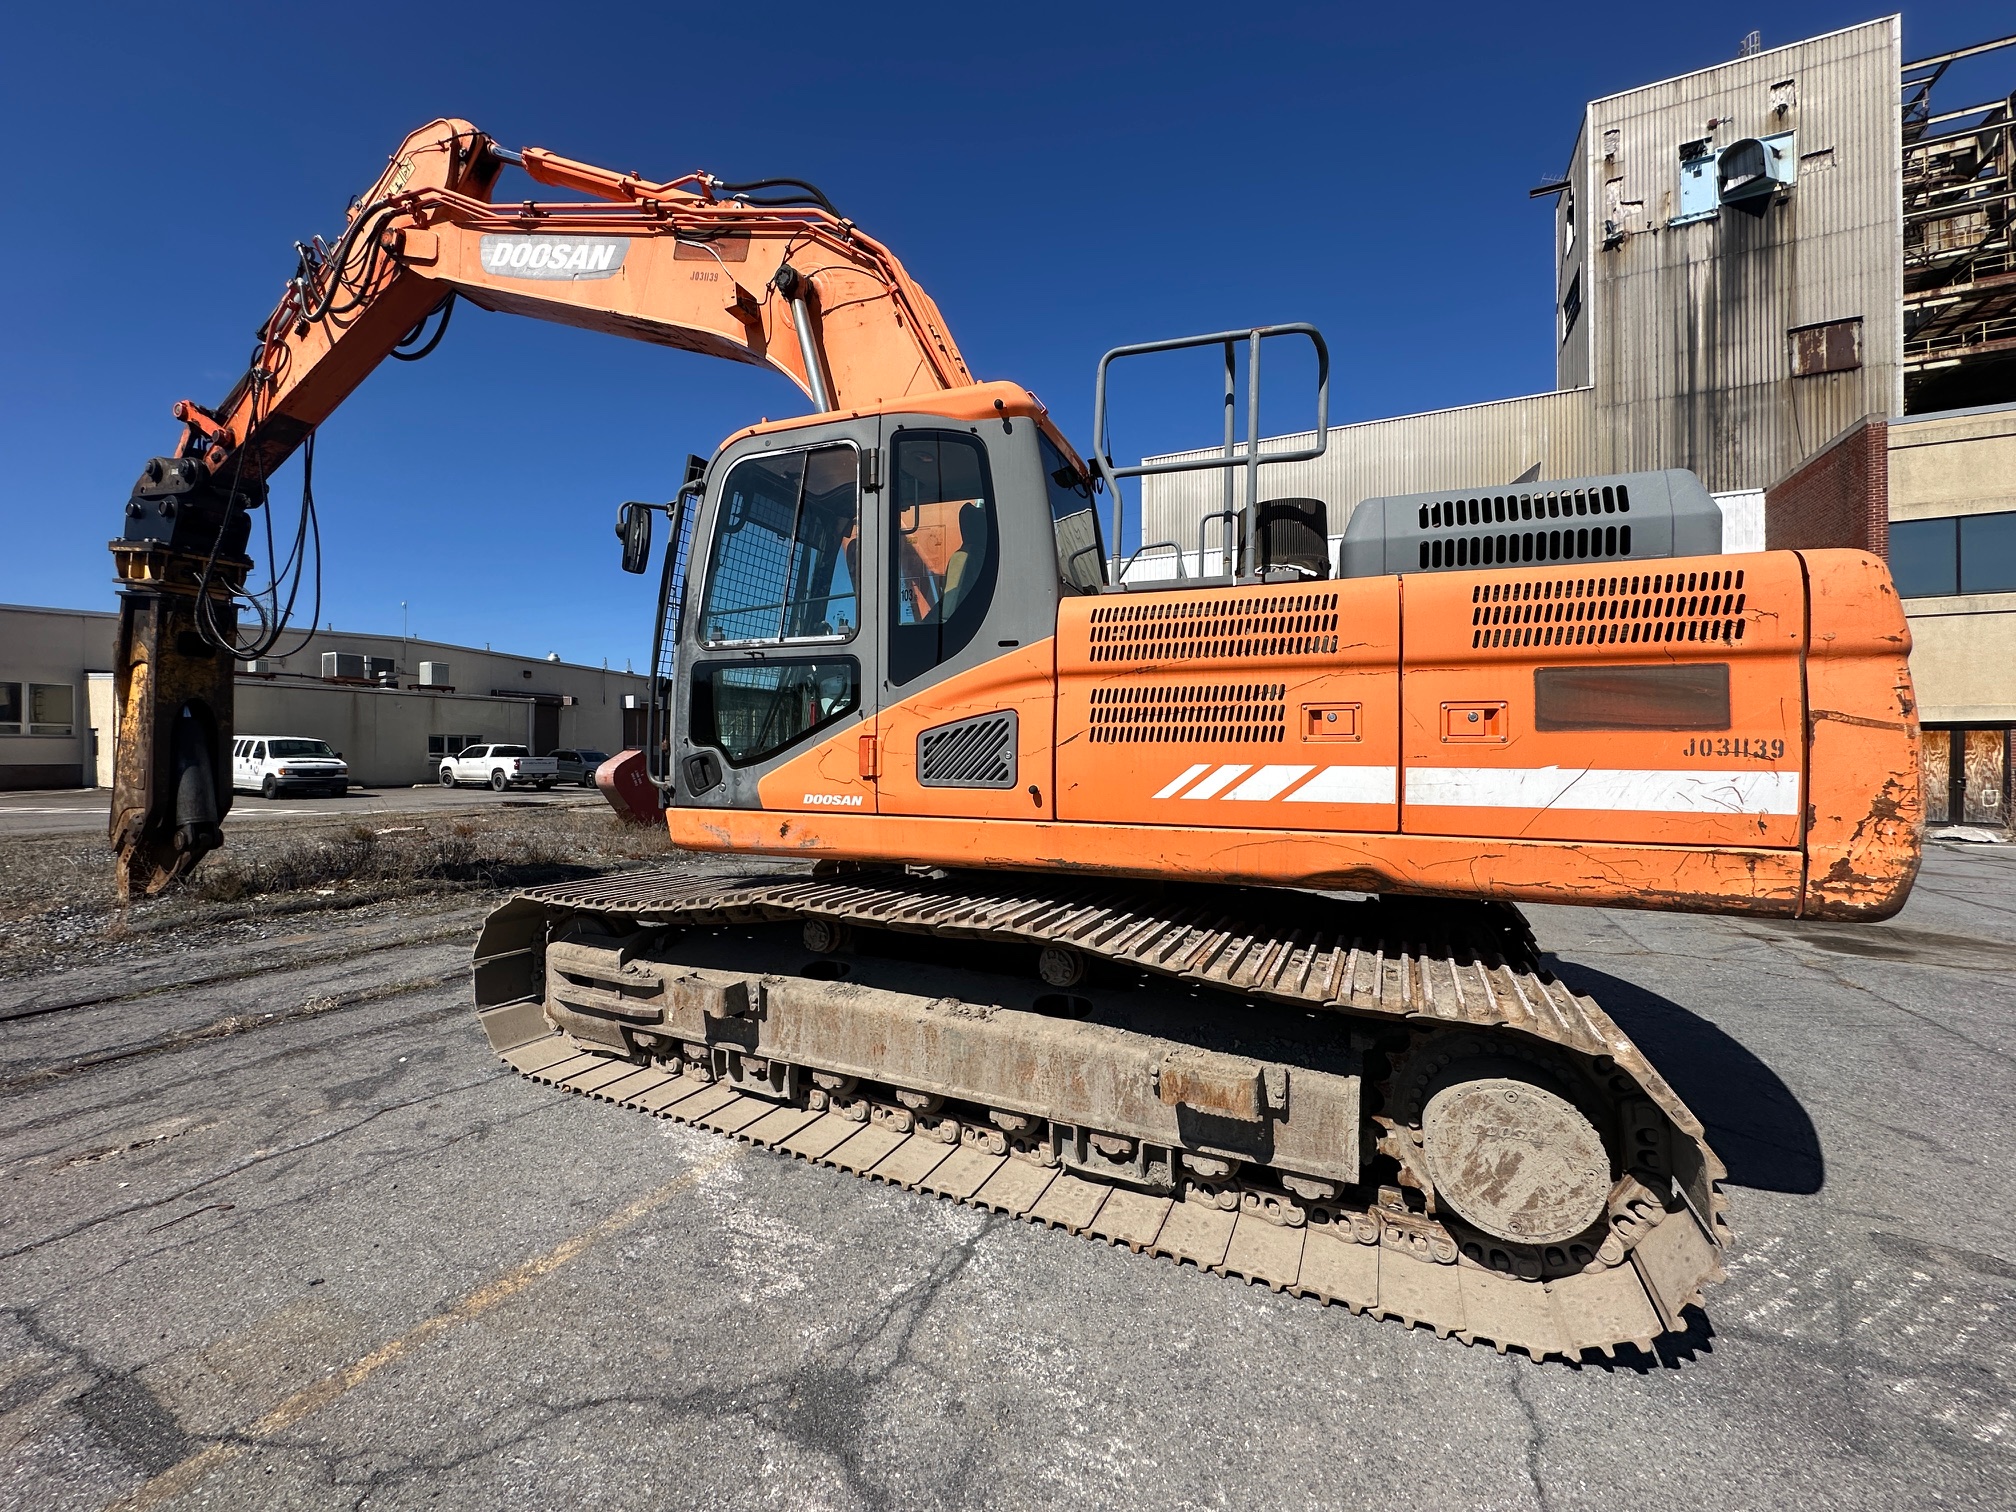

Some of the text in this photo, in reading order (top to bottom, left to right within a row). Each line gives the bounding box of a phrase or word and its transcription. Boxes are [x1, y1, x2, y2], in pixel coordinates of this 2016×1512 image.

[489, 242, 617, 270] DOOSAN
[1683, 738, 1785, 759] J031139
[803, 793, 863, 806] DOOSAN
